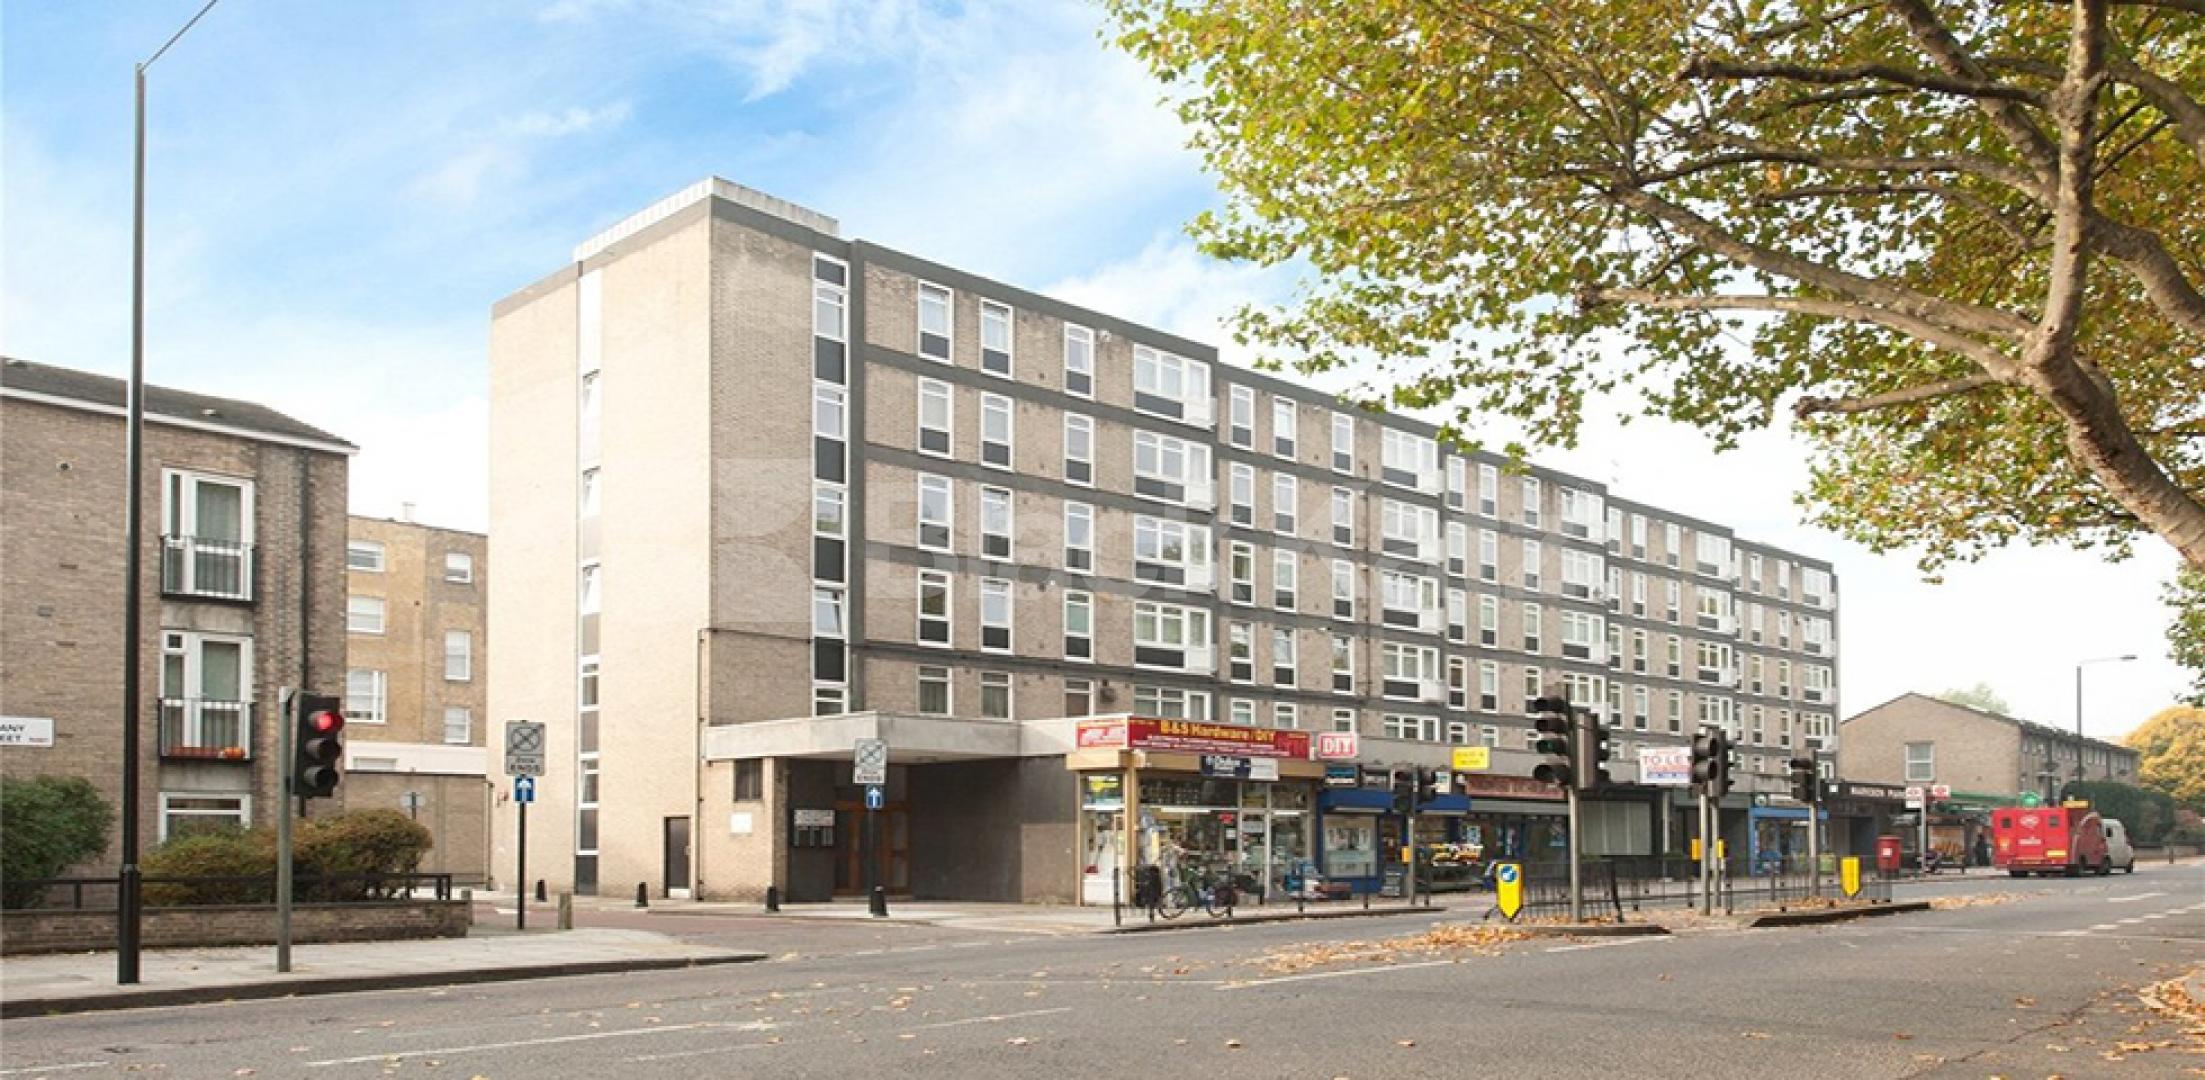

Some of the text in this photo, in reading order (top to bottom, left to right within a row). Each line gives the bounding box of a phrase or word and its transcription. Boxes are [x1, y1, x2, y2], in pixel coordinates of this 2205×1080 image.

[1160, 720, 1189, 735] B&S
[1191, 723, 1250, 740] Hardware
[1322, 738, 1353, 753] DIY
[1642, 755, 1662, 766] TO
